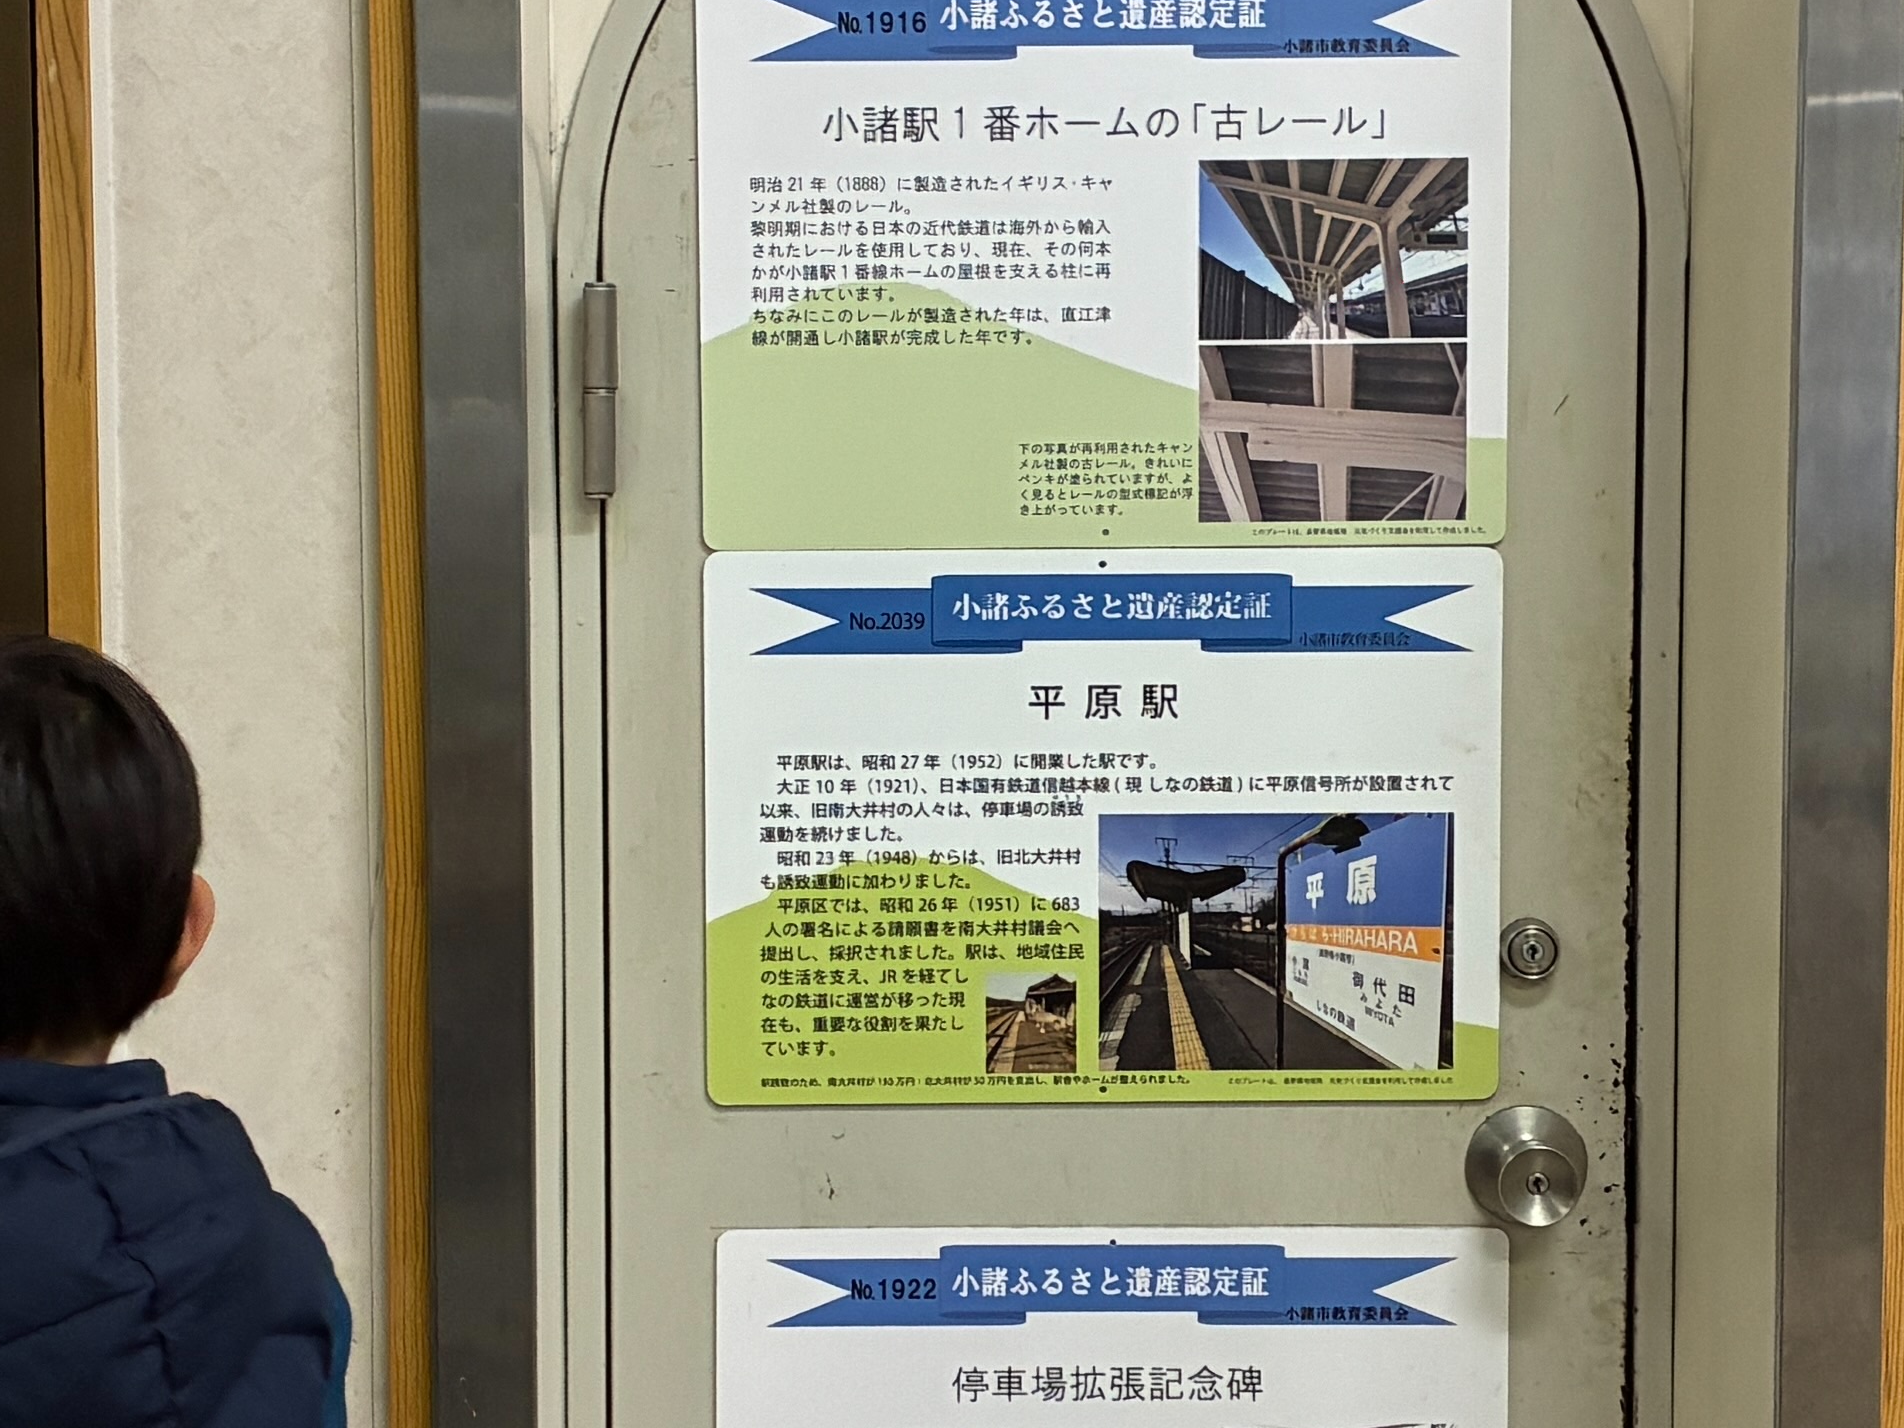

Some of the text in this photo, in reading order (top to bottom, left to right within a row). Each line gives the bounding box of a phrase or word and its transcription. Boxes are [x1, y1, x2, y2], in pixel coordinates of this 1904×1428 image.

[1283, 37, 1410, 54] 小諸市教育委員会
[823, 103, 1385, 143] 小諸駅１番ホームの「古レール」
[751, 199, 912, 215] ンメル社製のレール。
[751, 221, 1111, 236] 黎明期における日本の近代鉄道は海外から輸入
[751, 242, 1111, 258] されたレールを使用しており、現在、その何本
[751, 263, 1110, 280] かが小諸駅１番線ホームの屋根を支える柱に再
[751, 286, 897, 302] 利用されています。
[752, 307, 1111, 323] ちなみにこのレールが製造された年は、直江津
[751, 330, 1033, 346] 線が開通し小諸駅が完成した年です。
[849, 590, 1273, 631] No.2039 小諸ふるさと遺産認定証
[1298, 631, 1410, 648] 小諸市教育委員会
[1028, 684, 1179, 720] 平原駅
[760, 801, 1083, 818] 以来、旧南大井村の人々は、停車場の誘致
[759, 827, 903, 842] 運動を続けました。
[760, 875, 971, 890] も誘致運動に加わりました。
[1306, 855, 1377, 909] 平原
[765, 921, 1080, 937] 人の署名による請願書を南大井村議会へ
[760, 945, 1084, 961] 提出し、採択されました。駅は、地域住民
[761, 993, 965, 1008] なの鉄道に運営が移った現
[761, 1016, 964, 1032] 在も、重要な役割を果たし
[761, 1041, 835, 1056] ています。
[952, 1266, 1270, 1297] 小諸ふるさと遺産認定証
[1286, 1306, 1409, 1322] 小諸市教育委員会
[953, 1367, 1265, 1404] 停車場拡張記念碑
